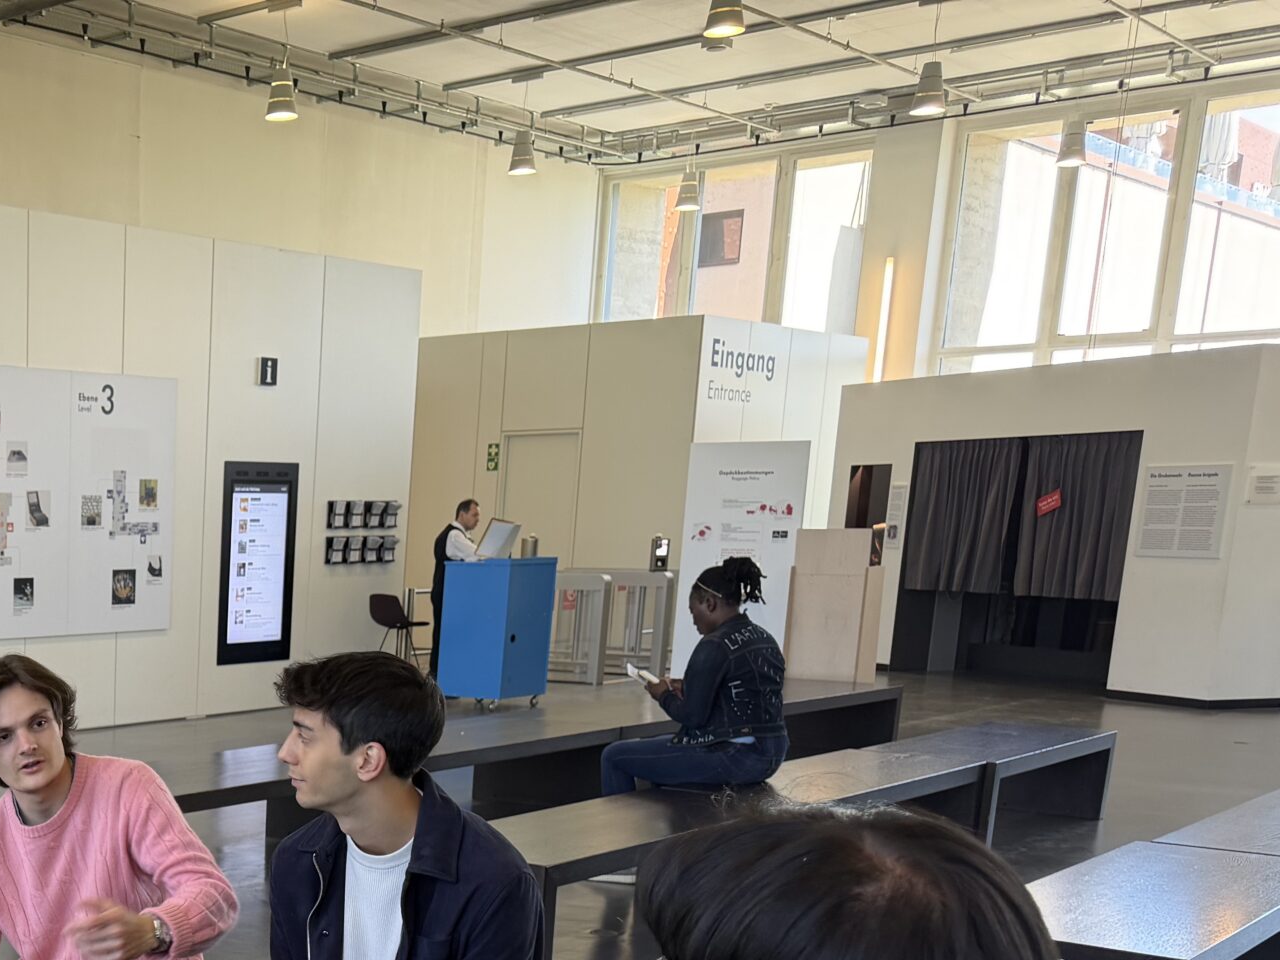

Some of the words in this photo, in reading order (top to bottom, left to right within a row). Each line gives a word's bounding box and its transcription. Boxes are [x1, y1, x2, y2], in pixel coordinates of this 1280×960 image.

[711, 338, 776, 381] Eingang
[78, 392, 98, 402] Ebene
[101, 384, 114, 415] 3
[707, 380, 752, 403] Entrance
